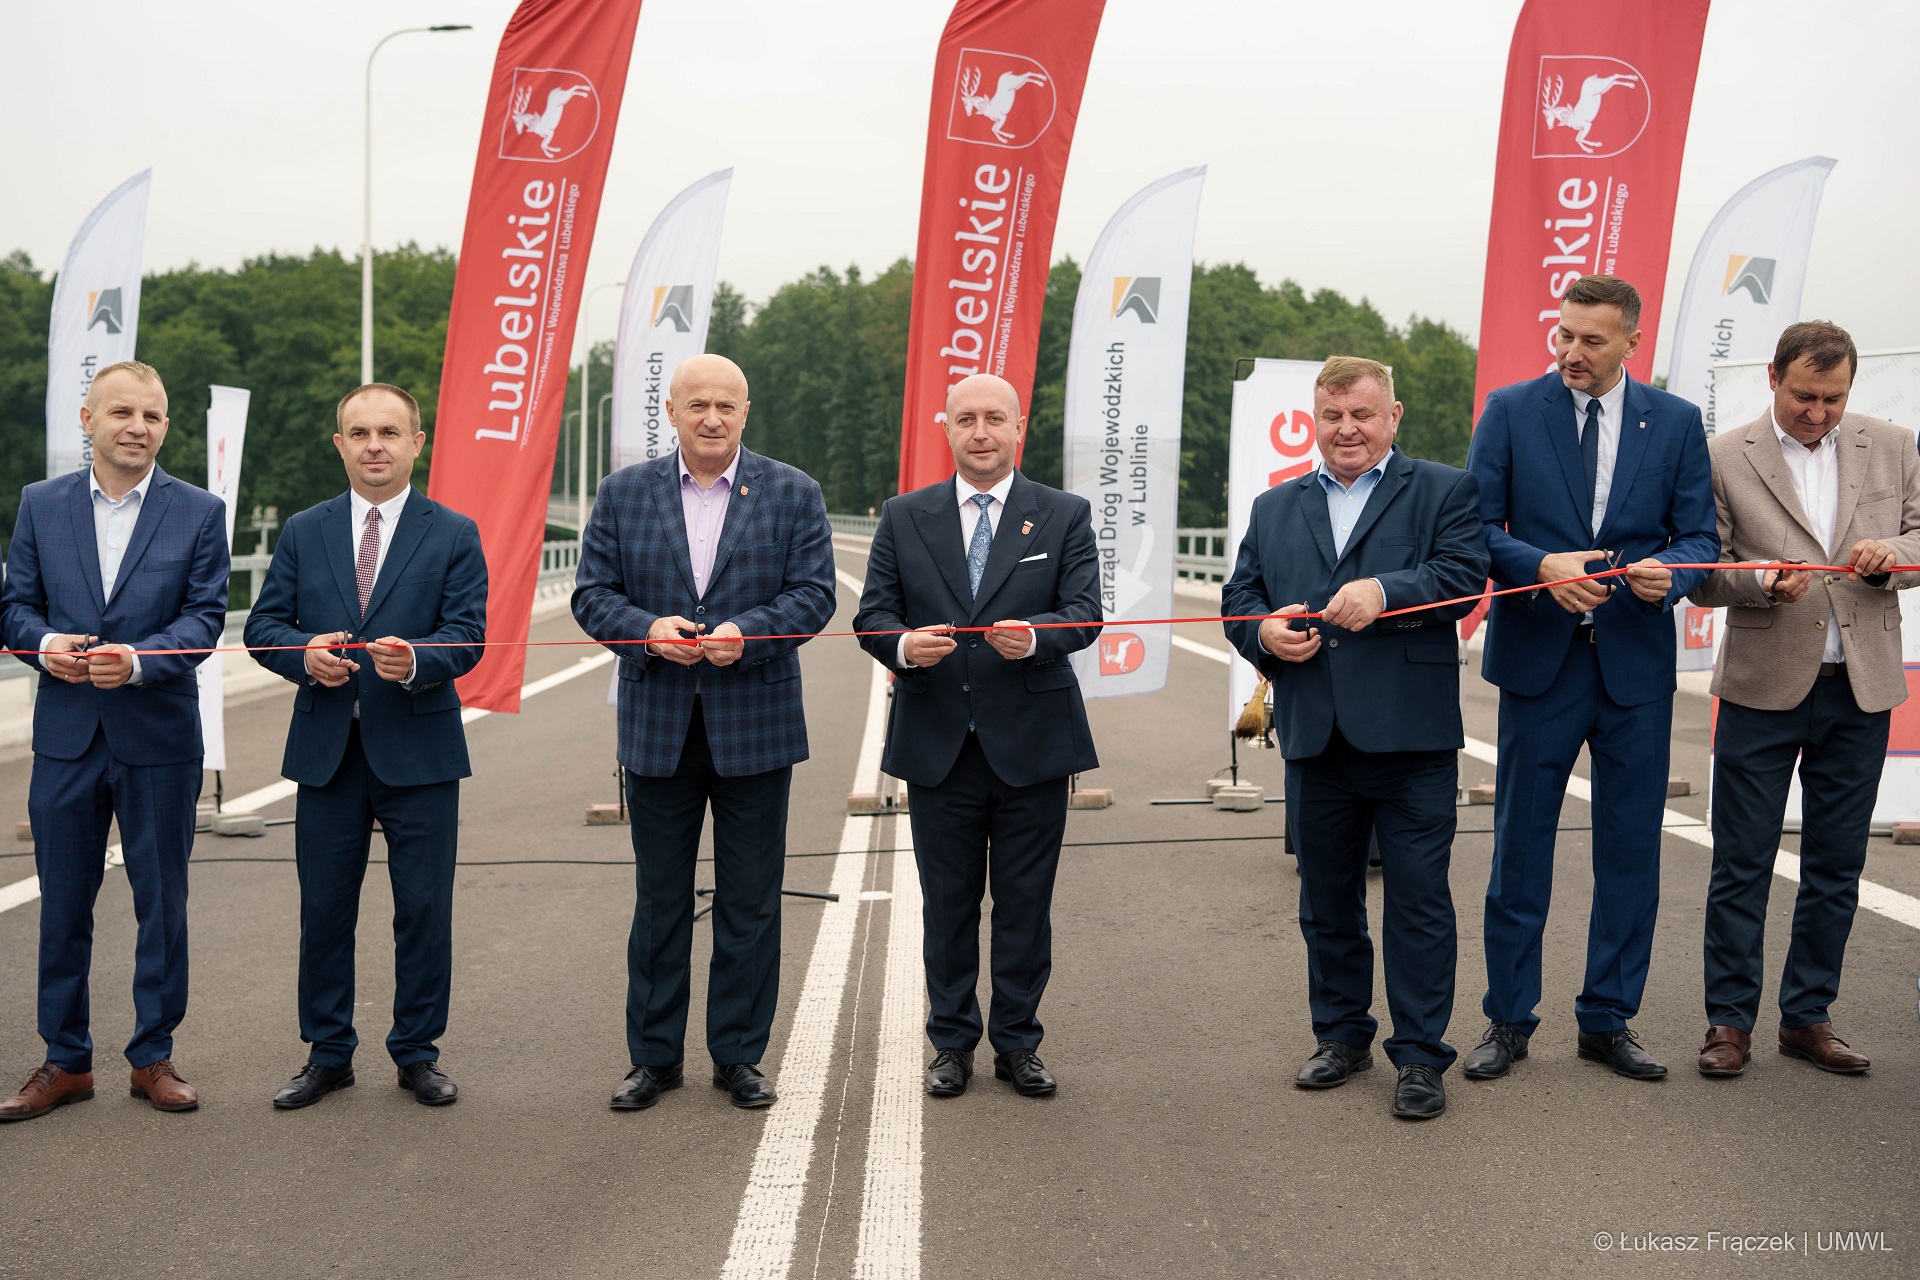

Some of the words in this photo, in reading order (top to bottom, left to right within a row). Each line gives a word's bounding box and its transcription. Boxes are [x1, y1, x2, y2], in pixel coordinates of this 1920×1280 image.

[547, 253, 569, 328] Województwa
[559, 184, 580, 250] Lubelskiego
[1003, 241, 1025, 314] Województwa
[1016, 173, 1036, 238] Lubelskiego
[1605, 183, 1629, 254] Lubelskiego
[475, 180, 555, 441] Lubelskie
[934, 164, 1011, 423] belskie
[1100, 342, 1124, 486] Wojewódzkich
[1128, 424, 1149, 503] Lublinie
[1099, 493, 1122, 541] Dróg
[1132, 510, 1146, 527] w
[1099, 548, 1121, 614] Zarząd
